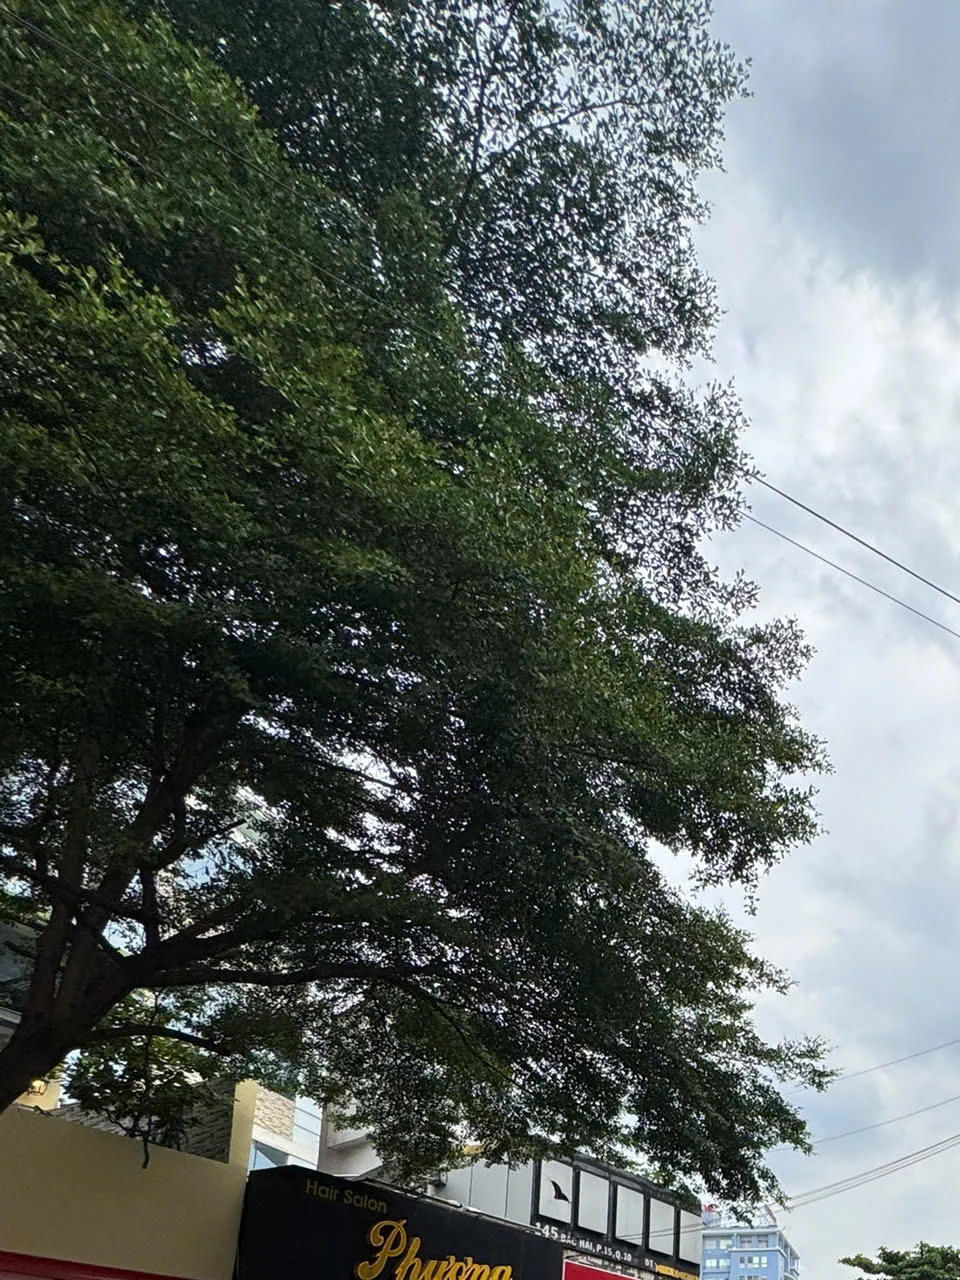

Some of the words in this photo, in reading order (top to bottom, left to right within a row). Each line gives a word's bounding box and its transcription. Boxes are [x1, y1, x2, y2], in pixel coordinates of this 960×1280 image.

[306, 1180, 339, 1201] Hair
[344, 1189, 388, 1214] Salon
[534, 1223, 558, 1239] 145
